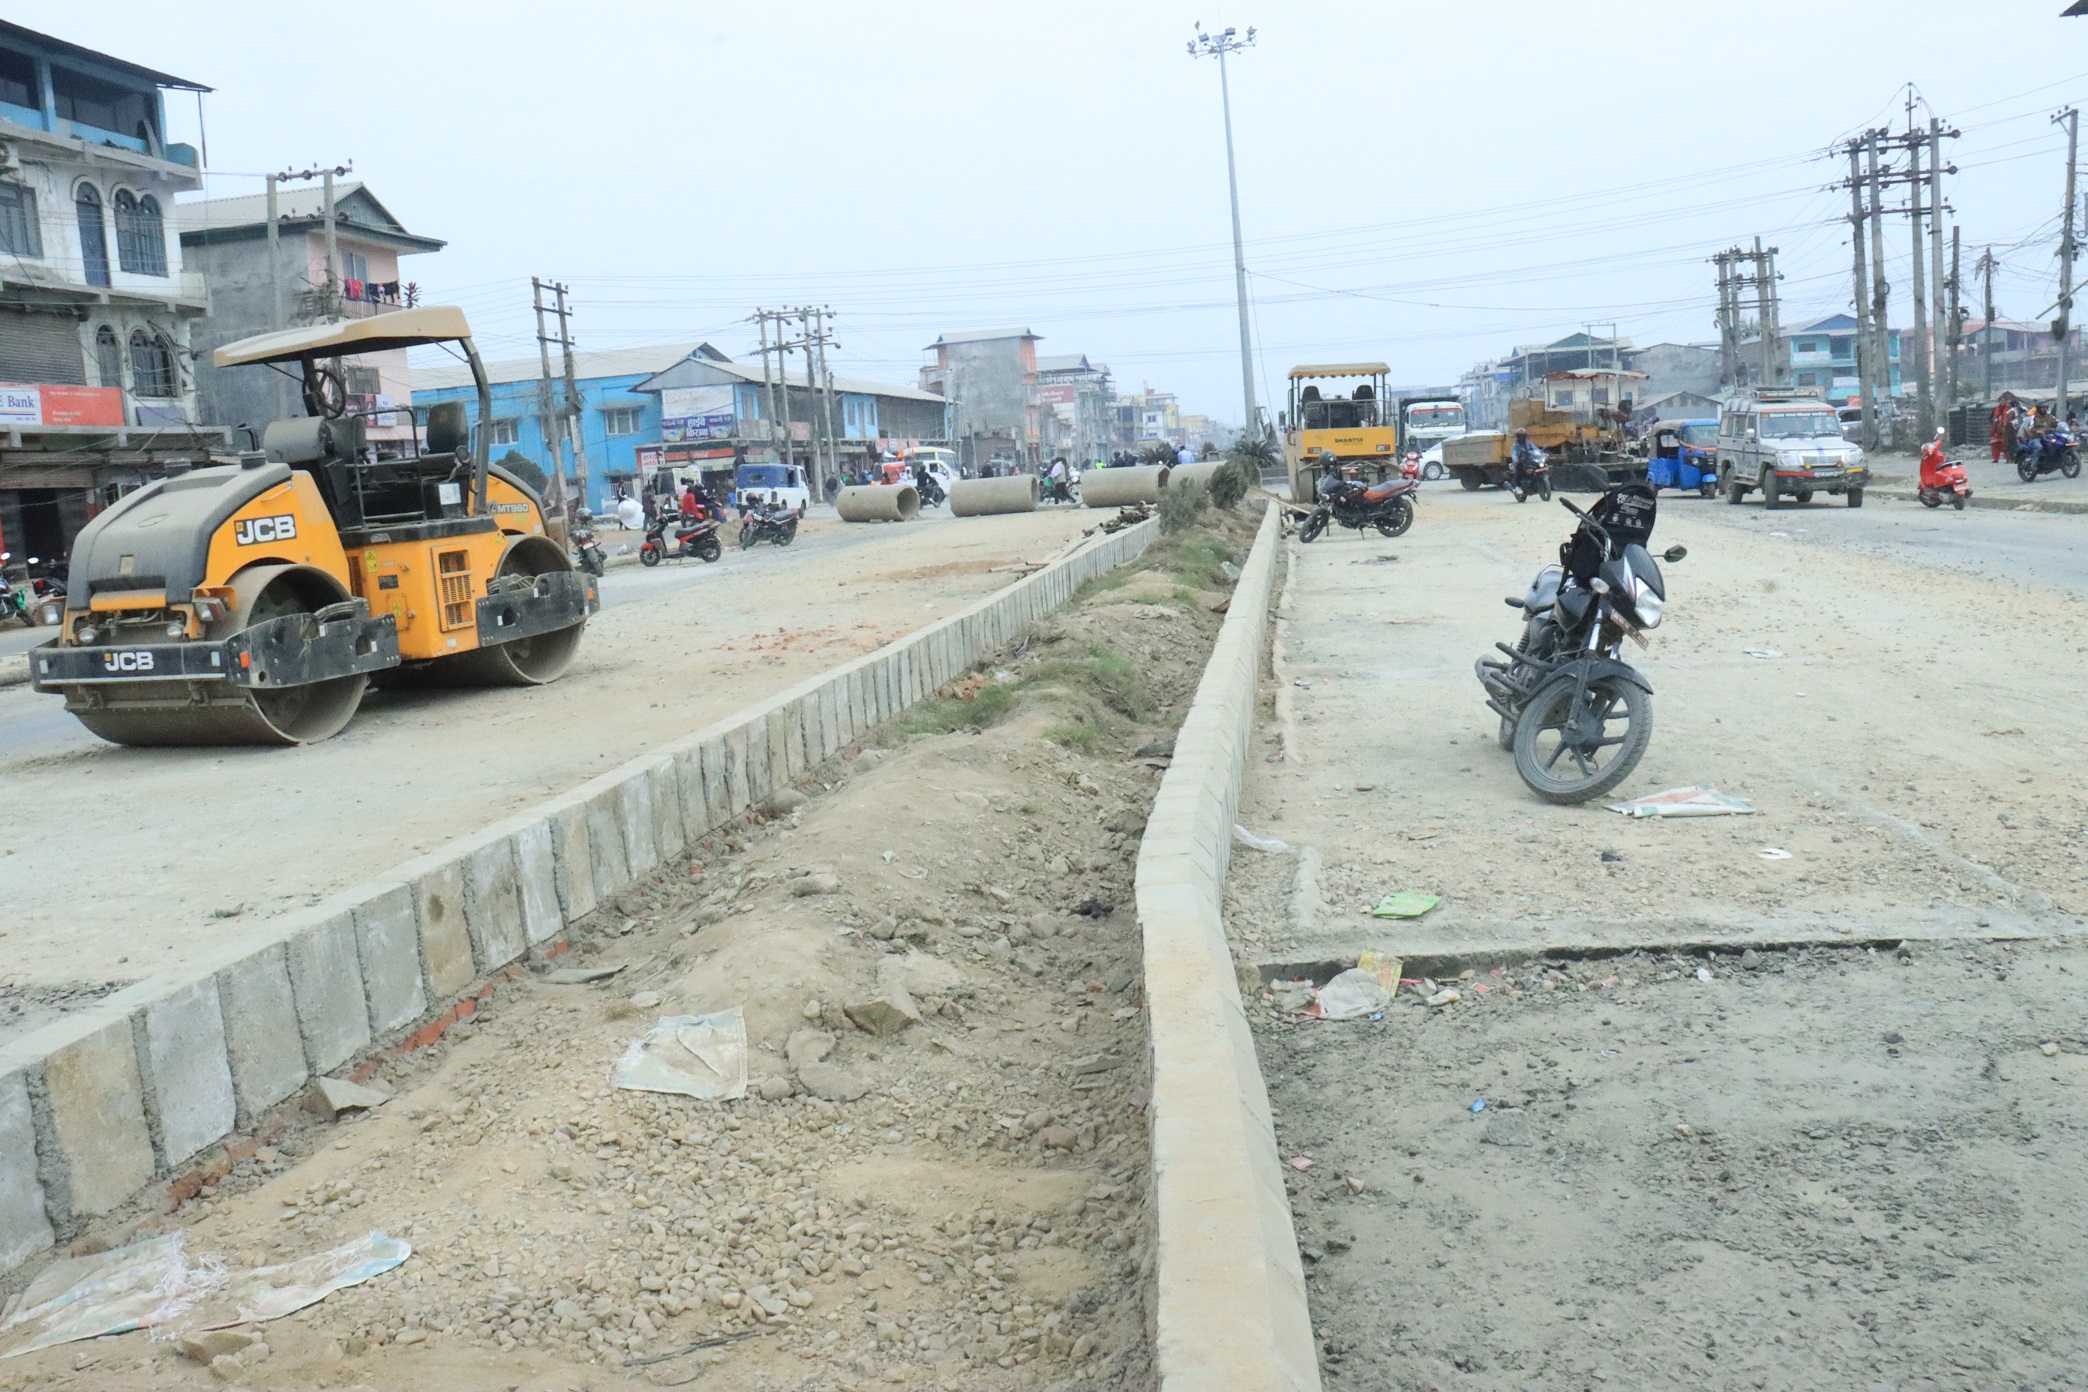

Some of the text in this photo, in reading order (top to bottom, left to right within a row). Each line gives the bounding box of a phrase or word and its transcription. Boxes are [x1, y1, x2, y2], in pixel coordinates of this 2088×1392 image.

[8, 395, 35, 408] Bank
[236, 515, 296, 545] JCB
[104, 651, 155, 671] JCB
